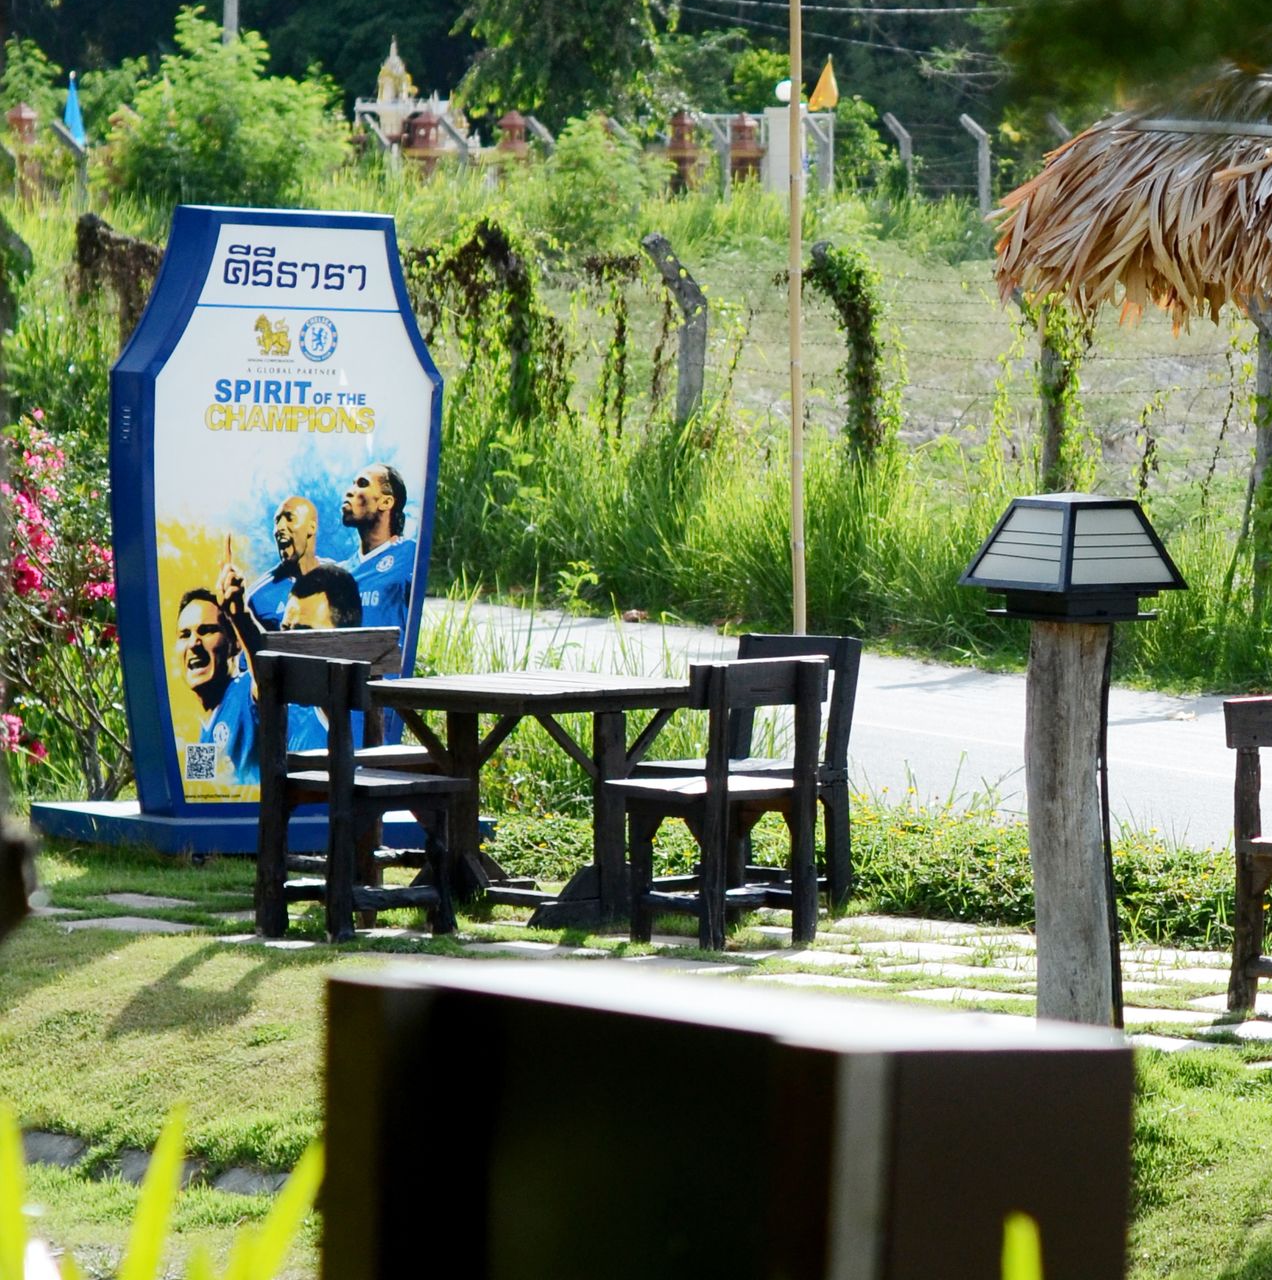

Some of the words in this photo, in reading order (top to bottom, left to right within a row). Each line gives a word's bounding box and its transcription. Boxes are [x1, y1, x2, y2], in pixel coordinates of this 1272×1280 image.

[223, 244, 367, 291] คีรีธารา
[256, 367, 292, 375] GLOBAL
[296, 368, 337, 376] PARTNER
[214, 378, 312, 405] SPIRIT
[313, 392, 333, 406] OF
[337, 393, 367, 406] THE
[204, 403, 376, 434] CHAMPIONS
